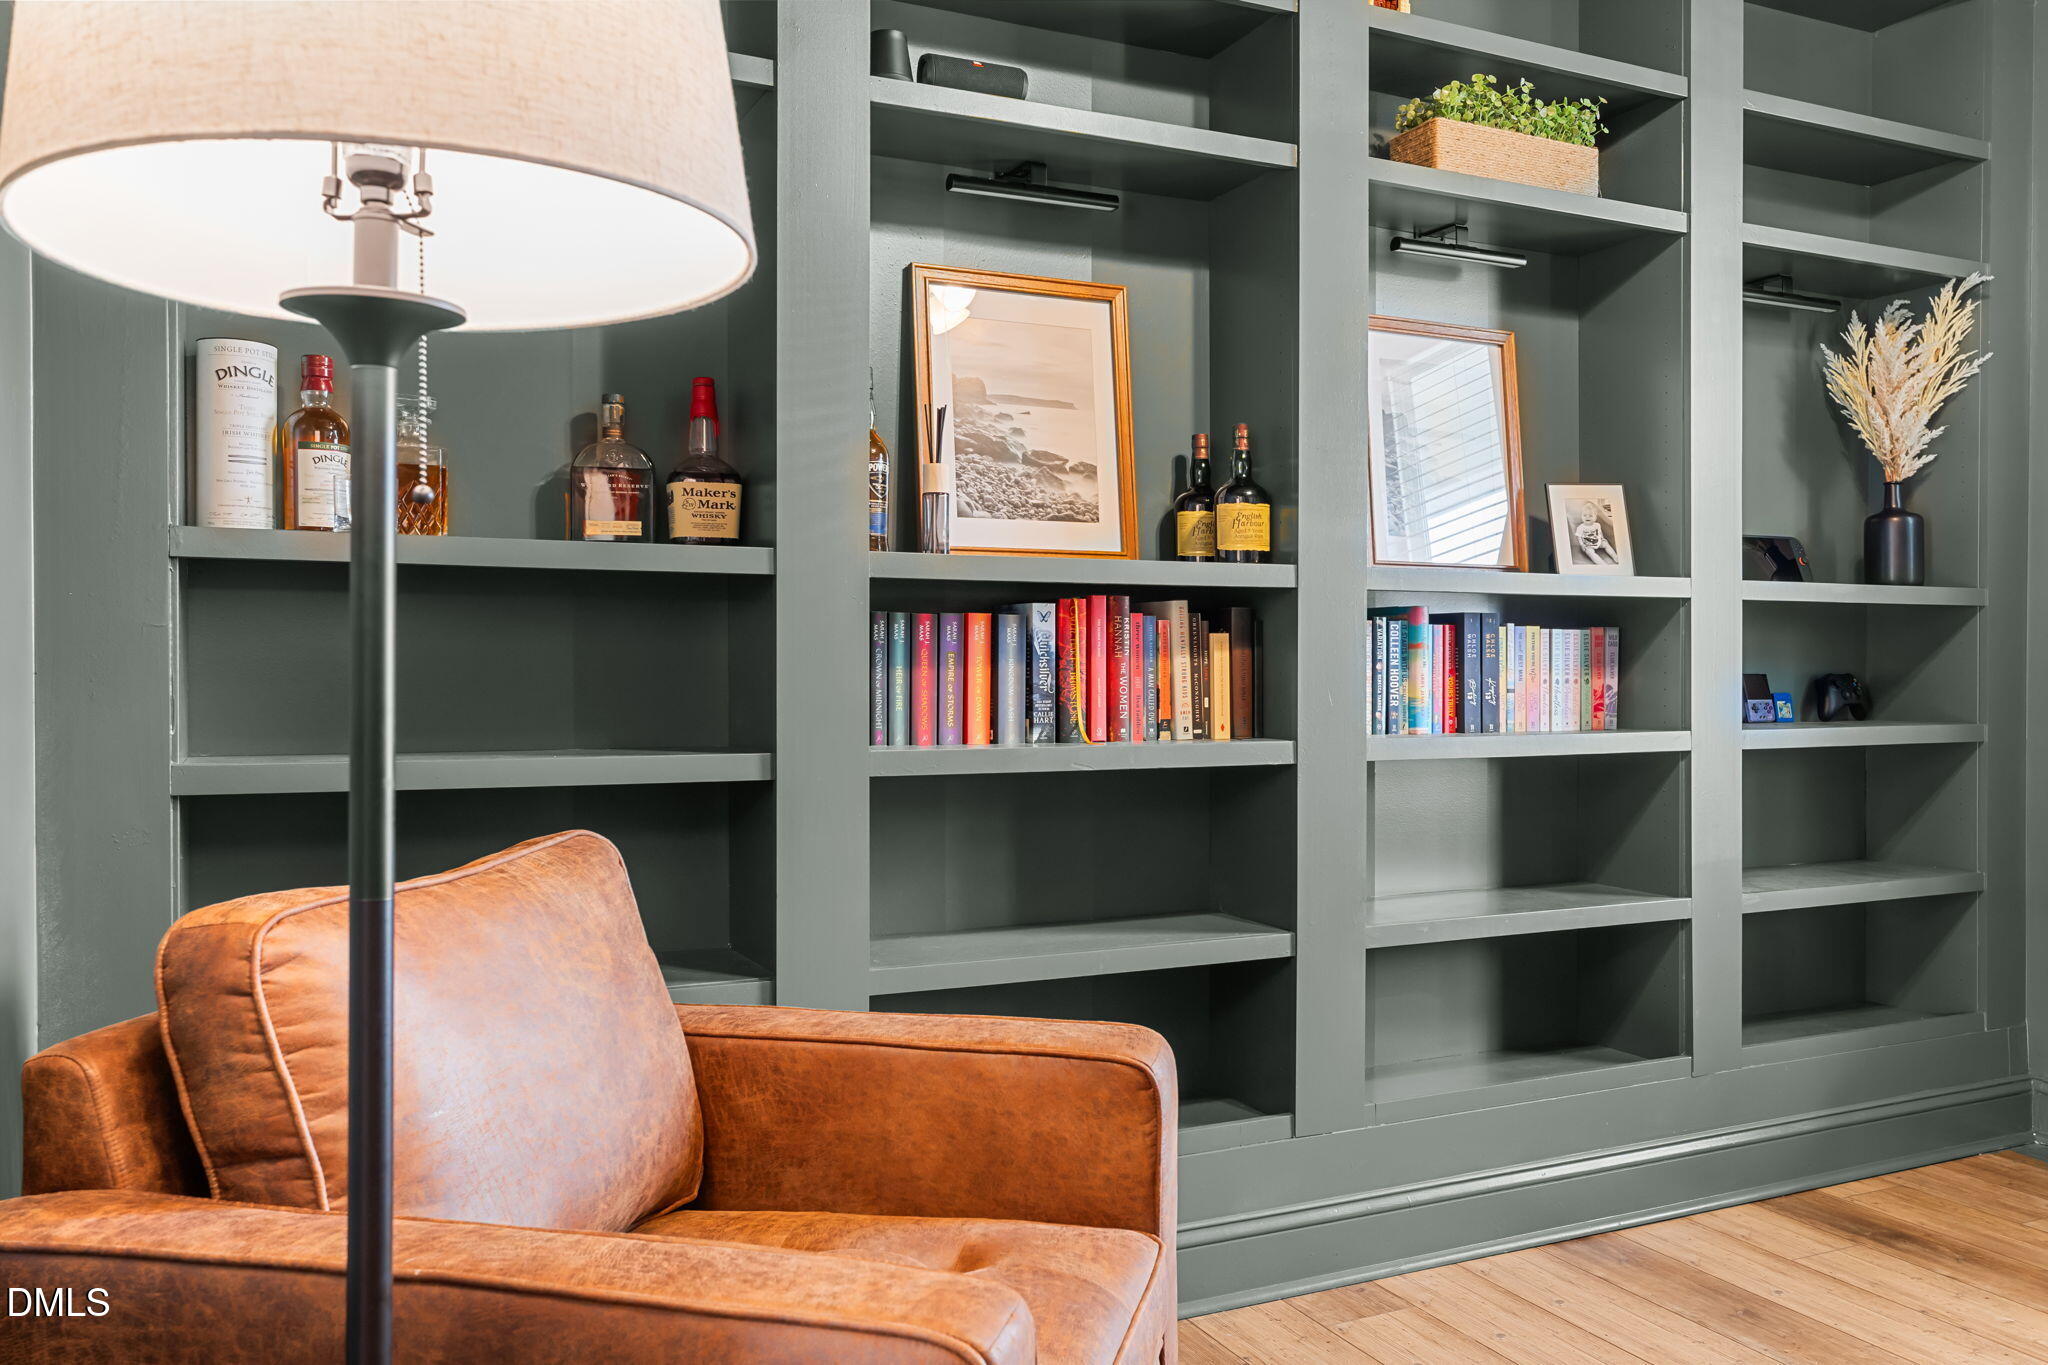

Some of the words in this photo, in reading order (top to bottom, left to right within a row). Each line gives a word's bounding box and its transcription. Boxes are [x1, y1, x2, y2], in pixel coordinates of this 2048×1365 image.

[214, 344, 243, 354] SINGLE
[245, 347, 260, 357] POT
[215, 365, 275, 388] DINGLE
[312, 454, 348, 469] DINGLE
[681, 487, 737, 498] Maker's
[697, 499, 736, 510] Mark
[1235, 511, 1263, 521] English
[1231, 518, 1265, 529] Harbour
[1178, 606, 1186, 629] RAISING
[1114, 615, 1123, 658] HANNAH
[1180, 631, 1188, 659] MENTALLY
[1390, 624, 1399, 666] COLLEEN
[875, 648, 883, 680] CROWN
[947, 653, 955, 682] EMPIRE
[975, 656, 983, 683] TOWER
[1033, 629, 1054, 694] Quicksilver
[1181, 661, 1189, 683] STRONG
[895, 666, 903, 684] HEIR
[1007, 658, 1015, 696] KINGDOM
[1401, 674, 1408, 682] US
[1119, 676, 1128, 720] WOMEN
[1390, 668, 1399, 707] HOOVER
[1485, 692, 1492, 700] 13
[875, 689, 883, 730] MIDNIGHT
[895, 695, 903, 712] FIRE
[947, 694, 955, 728] STORMS
[975, 696, 983, 722] DAWN
[1007, 706, 1015, 722] ASH
[1033, 716, 1054, 724] HART
